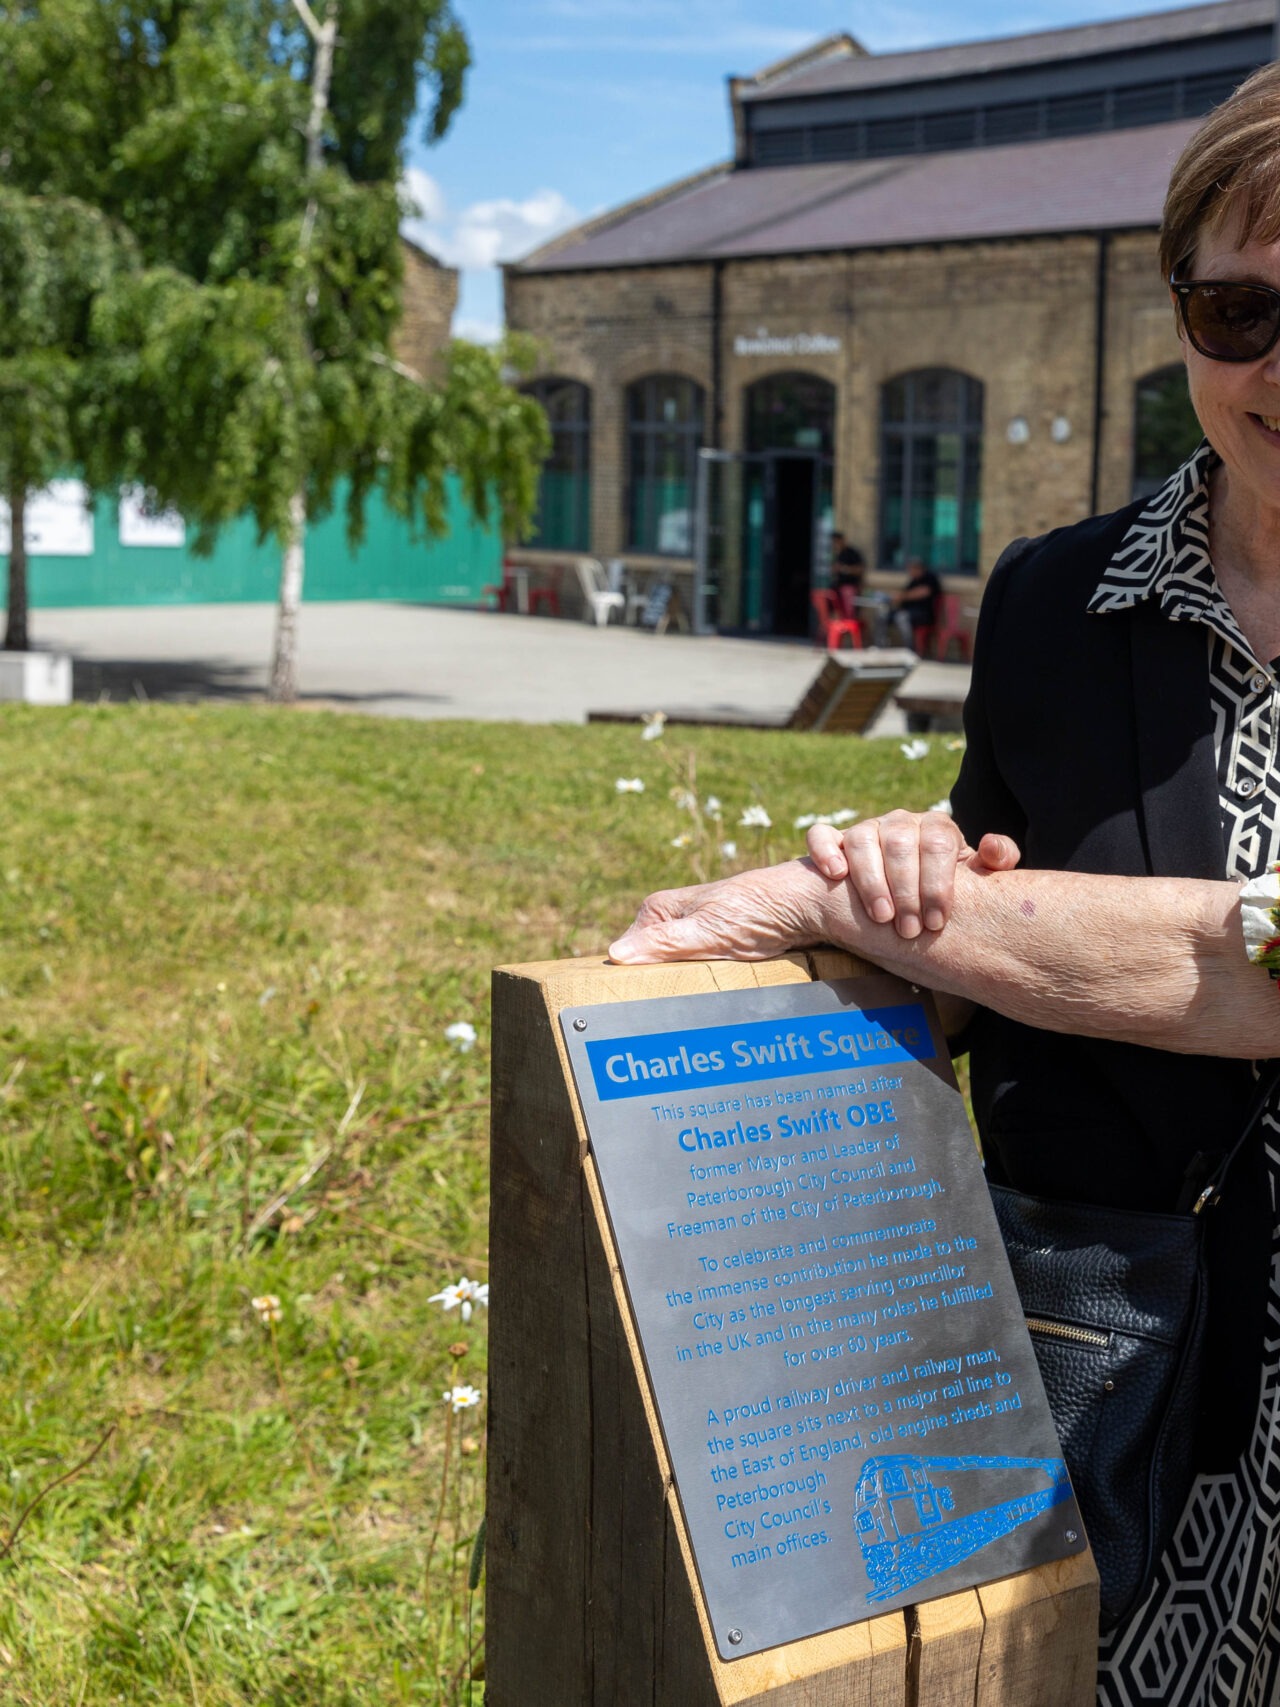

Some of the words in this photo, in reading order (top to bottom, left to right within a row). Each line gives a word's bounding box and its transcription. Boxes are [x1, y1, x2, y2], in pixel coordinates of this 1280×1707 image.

[605, 1045, 724, 1084] Charles
[732, 1032, 814, 1068] Swift
[822, 1025, 920, 1061] Square
[650, 1104, 686, 1121] This
[688, 1099, 742, 1119] square
[743, 1094, 773, 1110] has
[773, 1088, 815, 1106] been
[815, 1079, 868, 1100] named
[869, 1075, 902, 1093] after
[676, 1119, 773, 1154] Charles
[775, 1106, 844, 1140] Swift
[844, 1099, 897, 1129] OBE
[686, 1177, 795, 1209] Peterborough
[797, 1172, 827, 1192] City
[829, 1161, 885, 1186] Council
[888, 1156, 916, 1176] and
[688, 1160, 744, 1182] former
[746, 1153, 797, 1174] Mayor
[800, 1144, 831, 1165] and
[830, 1138, 881, 1160] Leader
[884, 1132, 900, 1151] of
[666, 1215, 738, 1239] Freeman
[740, 1207, 758, 1227] of
[759, 1205, 788, 1224] the
[789, 1200, 820, 1220] City
[822, 1193, 839, 1213] of
[841, 1178, 945, 1209] Peterborough.
[665, 1289, 694, 1308] the
[697, 1276, 770, 1302] immense
[773, 1257, 867, 1288] contribution
[867, 1252, 888, 1268] he
[891, 1243, 932, 1263] made
[933, 1241, 951, 1256] to
[952, 1235, 977, 1253] the
[697, 1255, 720, 1273] To
[722, 1244, 796, 1270] celebrate
[798, 1235, 828, 1256] and
[830, 1218, 937, 1250] commemorate
[675, 1345, 693, 1362] in
[695, 1340, 725, 1359] the
[726, 1332, 753, 1353] UK
[755, 1324, 786, 1347] and
[787, 1323, 805, 1339] in
[805, 1317, 833, 1336] the
[835, 1310, 877, 1328] many
[879, 1300, 917, 1319] roles
[917, 1295, 939, 1311] he
[939, 1281, 994, 1307] fulfilled
[692, 1312, 725, 1332] City
[728, 1308, 748, 1325] as
[748, 1301, 777, 1321] the
[778, 1288, 839, 1314] longest
[839, 1279, 895, 1302] serving
[896, 1264, 965, 1290] councillor
[782, 1349, 807, 1367] for
[809, 1343, 844, 1362] over
[847, 1334, 868, 1354] 60
[869, 1329, 913, 1354] years.
[706, 1408, 721, 1428] A
[722, 1395, 773, 1428] proud
[775, 1387, 829, 1411] railway
[833, 1375, 877, 1398] driver
[881, 1364, 910, 1387] and
[911, 1357, 962, 1379] railway
[964, 1348, 1002, 1366] man,
[706, 1435, 736, 1456] the
[738, 1423, 794, 1449] square
[795, 1416, 824, 1435] sits
[825, 1406, 860, 1427] next
[861, 1403, 879, 1419] to
[883, 1399, 893, 1414] a
[894, 1389, 938, 1410] major
[941, 1379, 965, 1399] rail
[965, 1375, 993, 1393] line
[993, 1371, 1012, 1387] to
[709, 1464, 740, 1485] the
[740, 1454, 778, 1478] East
[778, 1446, 796, 1468] of
[798, 1431, 867, 1463] England,
[869, 1423, 895, 1445] old
[897, 1414, 948, 1438] engine
[949, 1401, 993, 1425] sheds
[994, 1391, 1023, 1414] and
[715, 1469, 828, 1512] Peterborough
[723, 1519, 757, 1540] City
[759, 1497, 833, 1531] Council's
[730, 1543, 773, 1569] main
[775, 1529, 834, 1557] offices.
